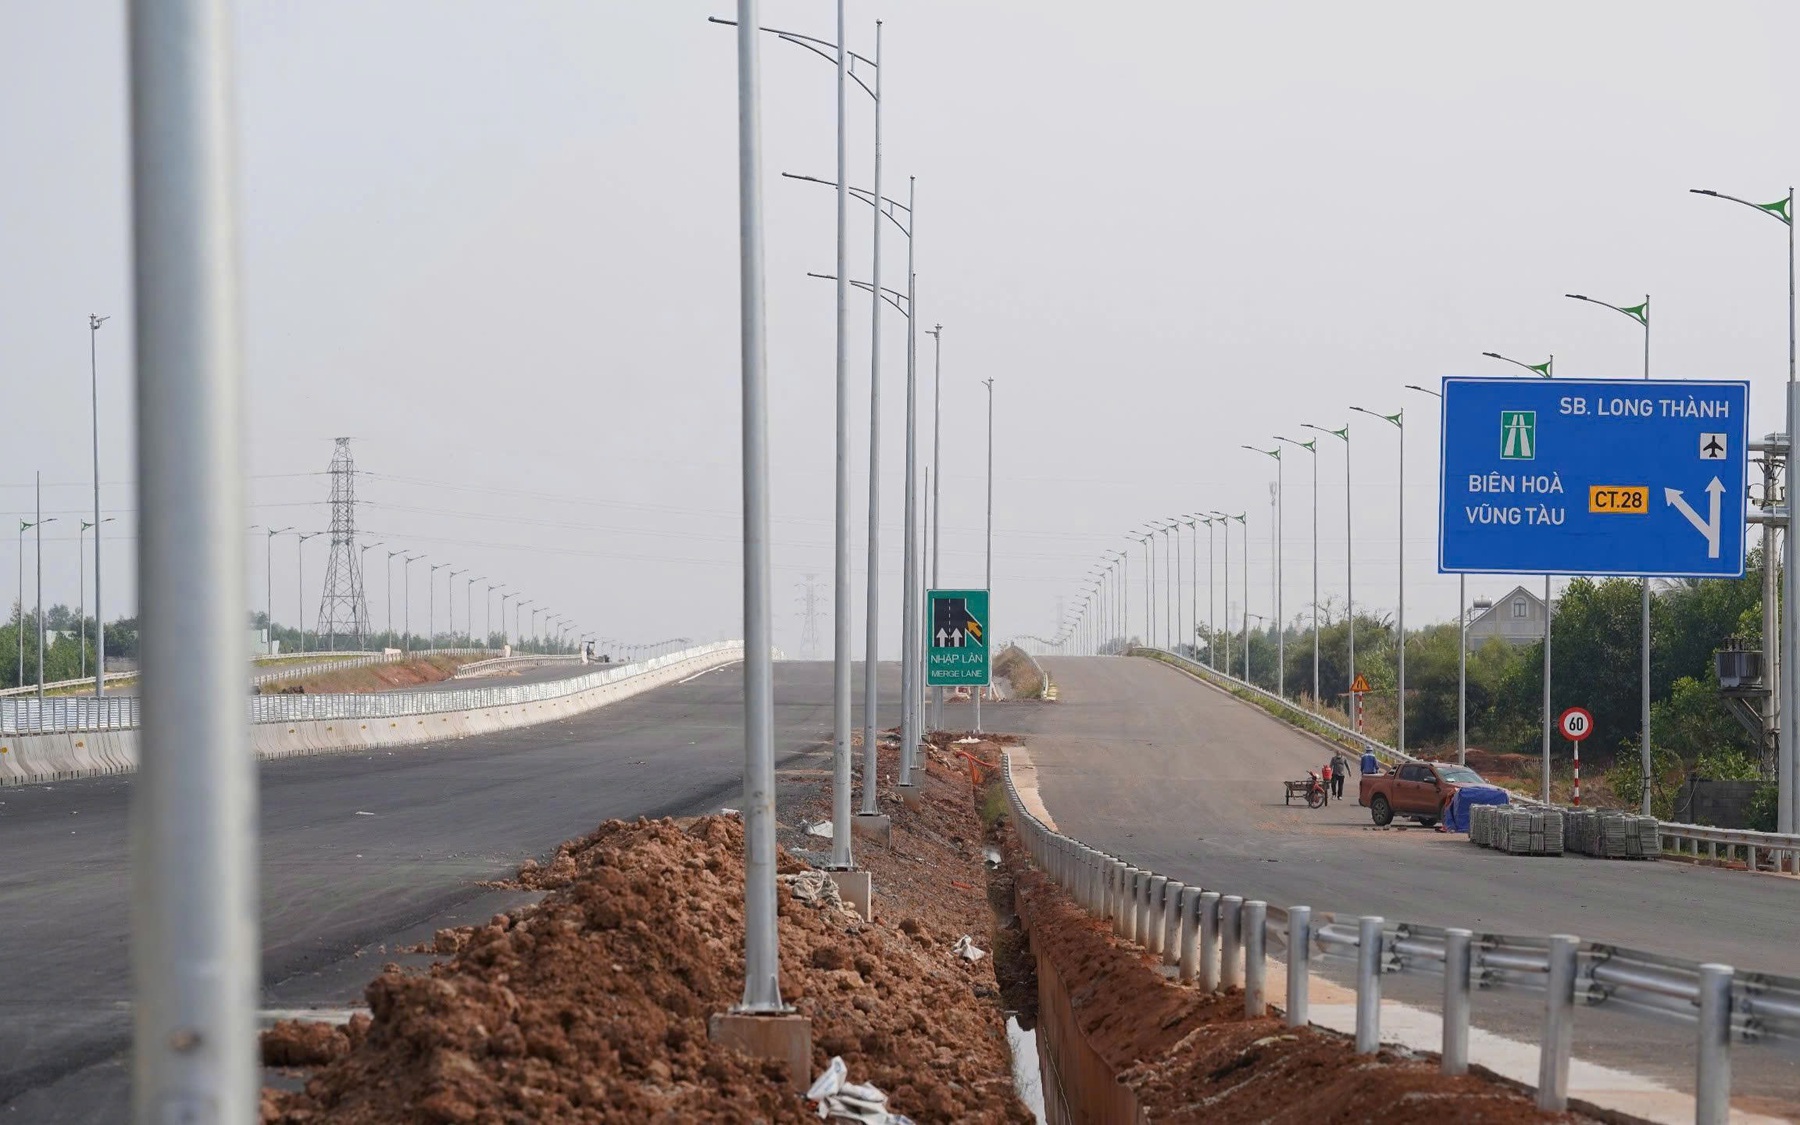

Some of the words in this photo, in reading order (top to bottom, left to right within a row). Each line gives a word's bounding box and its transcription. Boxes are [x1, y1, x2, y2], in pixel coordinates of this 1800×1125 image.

[1560, 396, 1591, 415] SB.
[1598, 398, 1653, 417] LONG
[1659, 394, 1728, 418] THÀNH
[1468, 471, 1515, 493] BIÊN
[1522, 472, 1564, 494] HOÀ
[1594, 491, 1642, 508] CT.28
[1466, 504, 1521, 525] VŨNG
[1525, 504, 1565, 525] TÀU
[1569, 717, 1584, 731] 60
